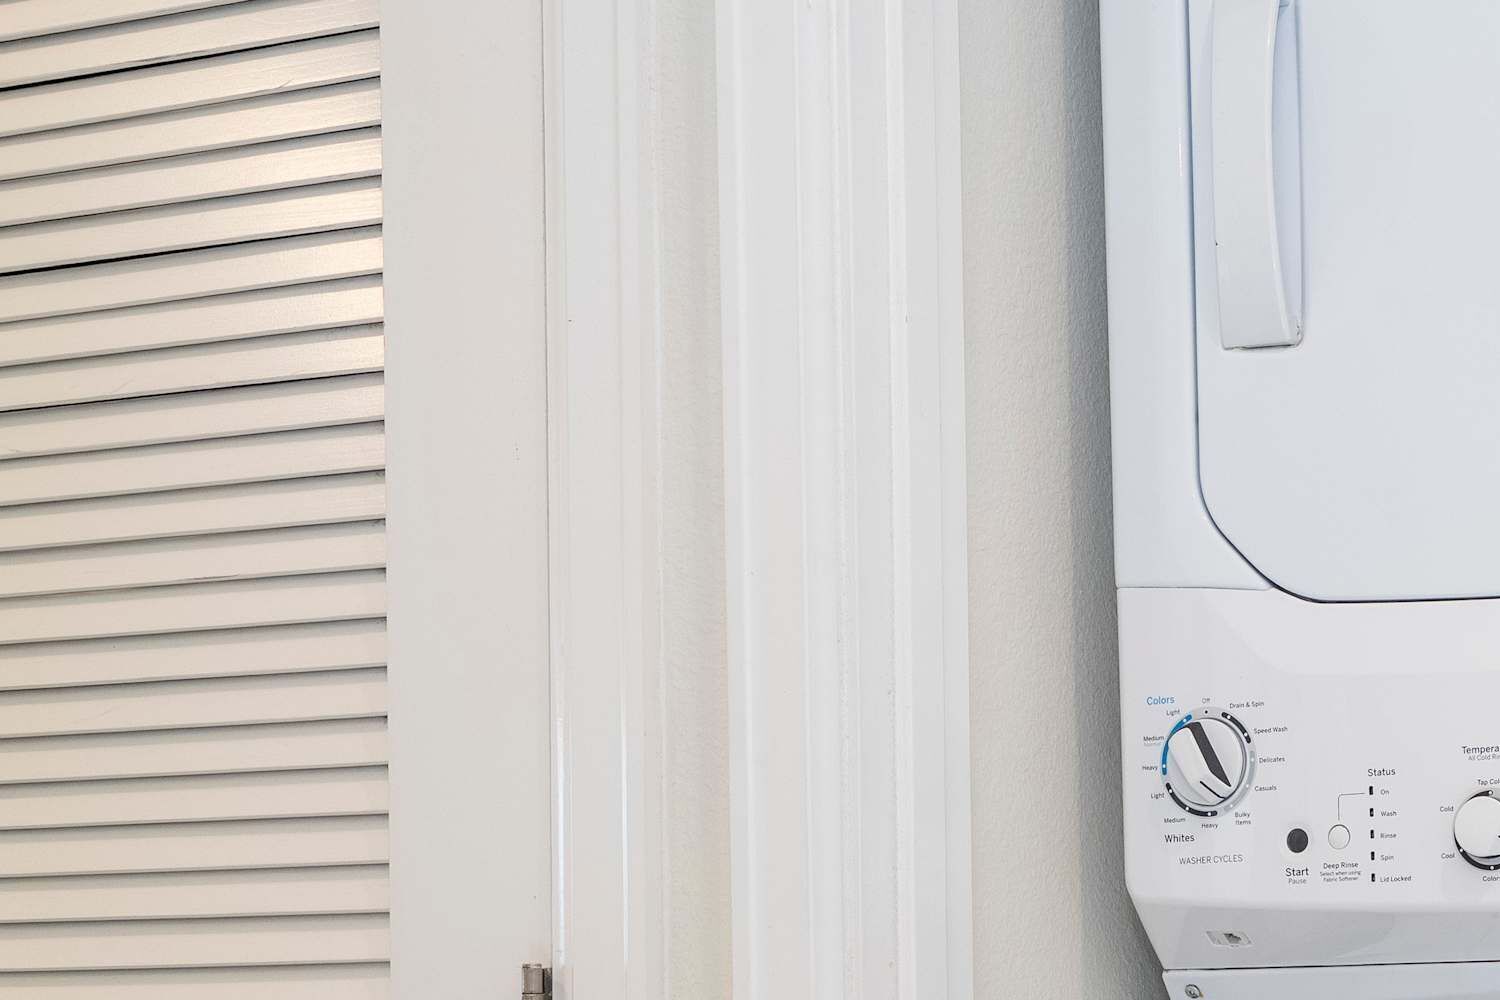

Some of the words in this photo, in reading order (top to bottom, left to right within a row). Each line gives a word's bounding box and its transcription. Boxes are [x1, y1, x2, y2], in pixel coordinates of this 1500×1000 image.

[1146, 696, 1175, 705] Colors
[1367, 768, 1396, 776] Status
[1164, 834, 1195, 843] Whites
[1179, 856, 1211, 864] WASHER
[1213, 854, 1243, 863] CYCLES
[1285, 867, 1309, 877] Start
